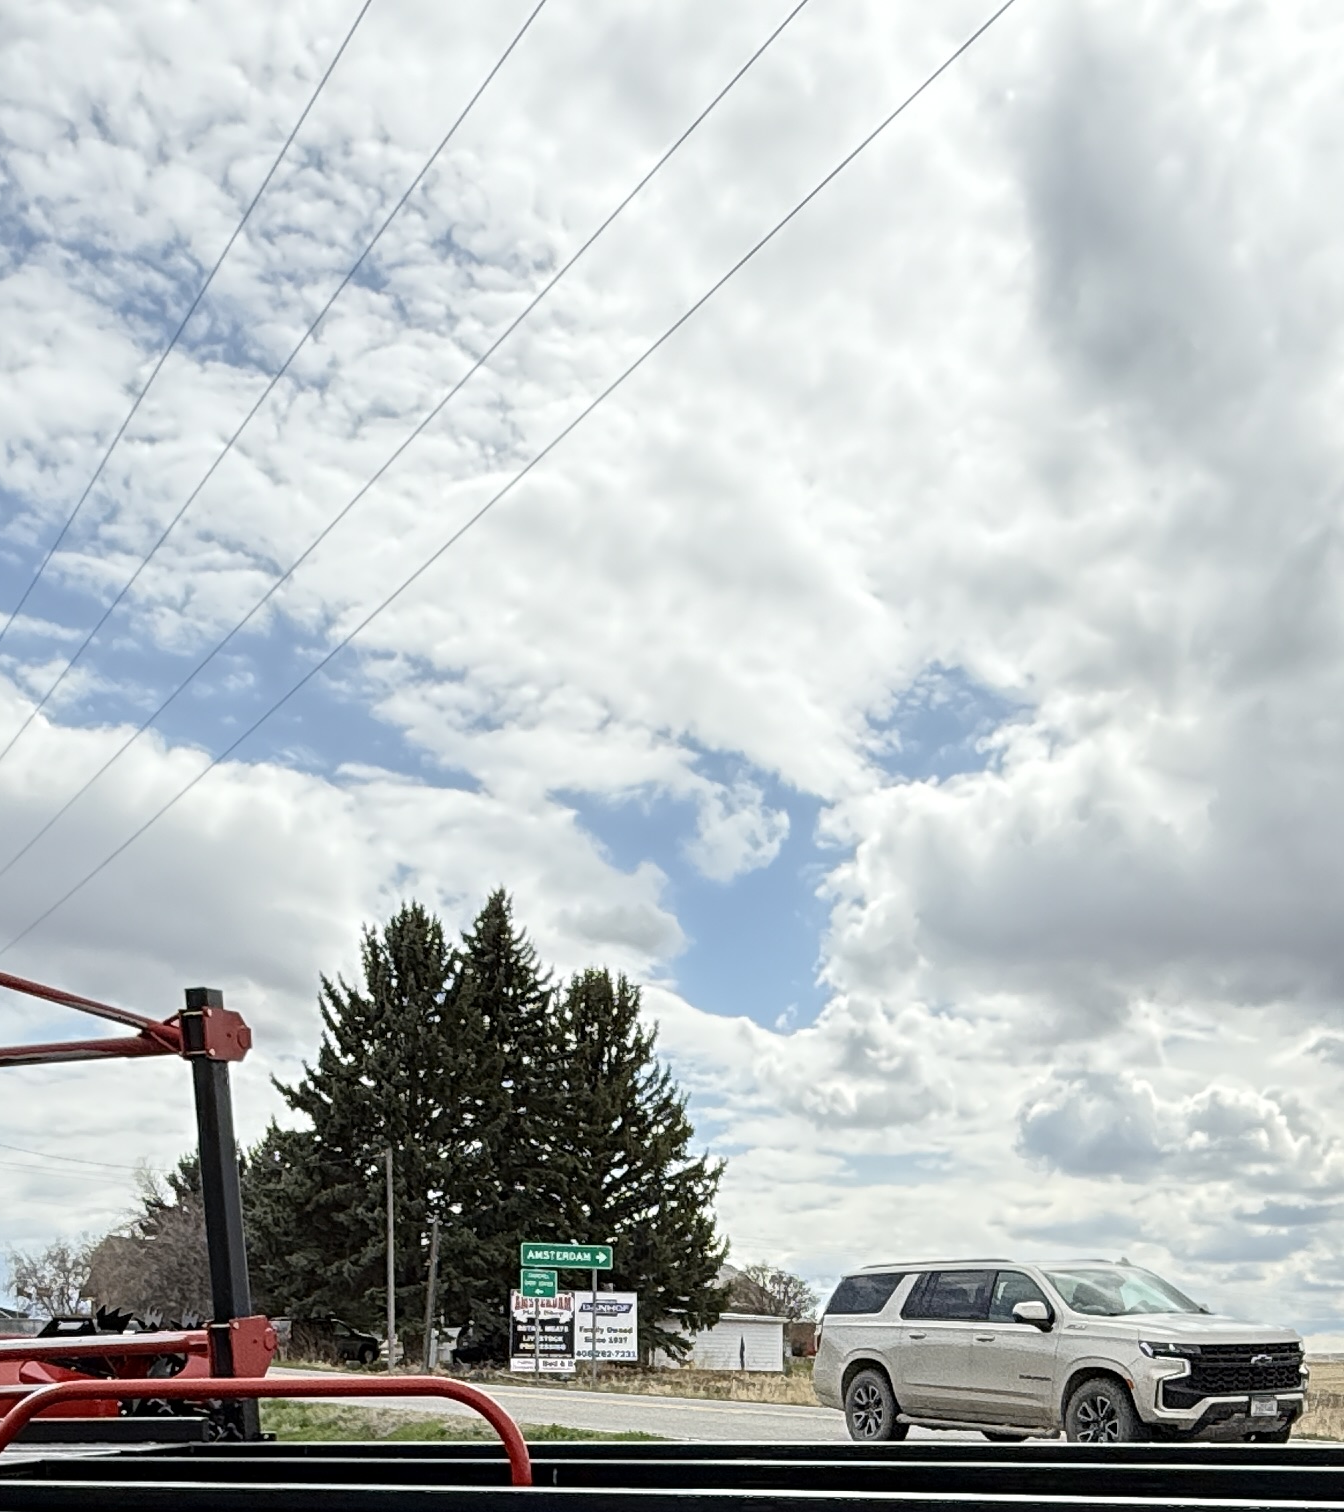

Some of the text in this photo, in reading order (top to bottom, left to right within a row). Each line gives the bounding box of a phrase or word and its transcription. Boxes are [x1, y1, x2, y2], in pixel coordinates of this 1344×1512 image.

[527, 1249, 591, 1261] AMSTERDAM
[515, 1296, 572, 1311] AMSERDAM
[517, 1324, 543, 1332] RETAL
[606, 1326, 633, 1334] Owned
[522, 1334, 564, 1342] LIVSTOCK
